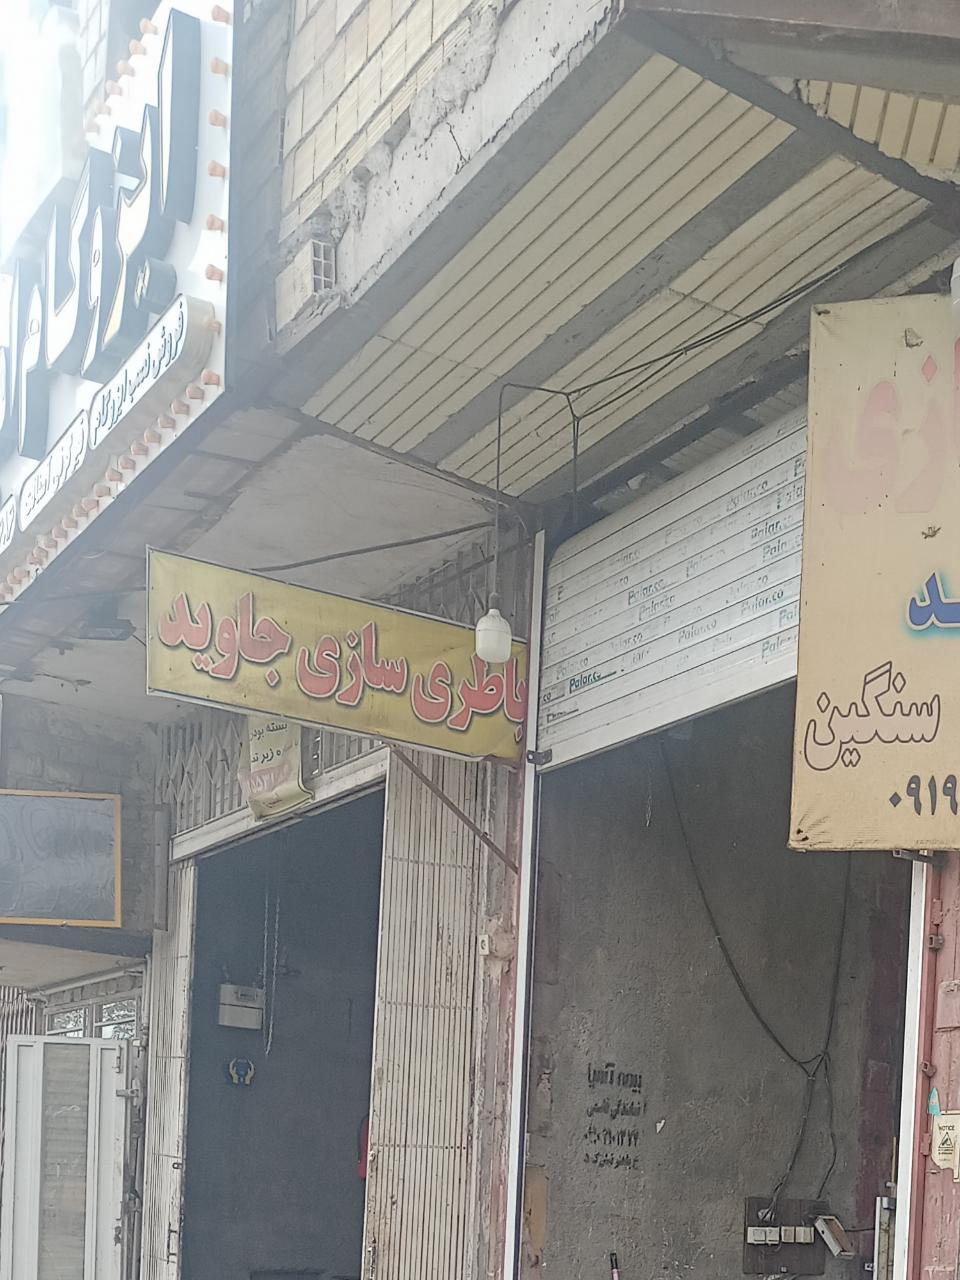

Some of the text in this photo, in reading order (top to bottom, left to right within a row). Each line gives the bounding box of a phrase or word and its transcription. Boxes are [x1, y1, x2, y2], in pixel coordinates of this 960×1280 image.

[158, 592, 292, 688] جاوید
[296, 621, 408, 706] سازی
[804, 660, 942, 772] سنگین
